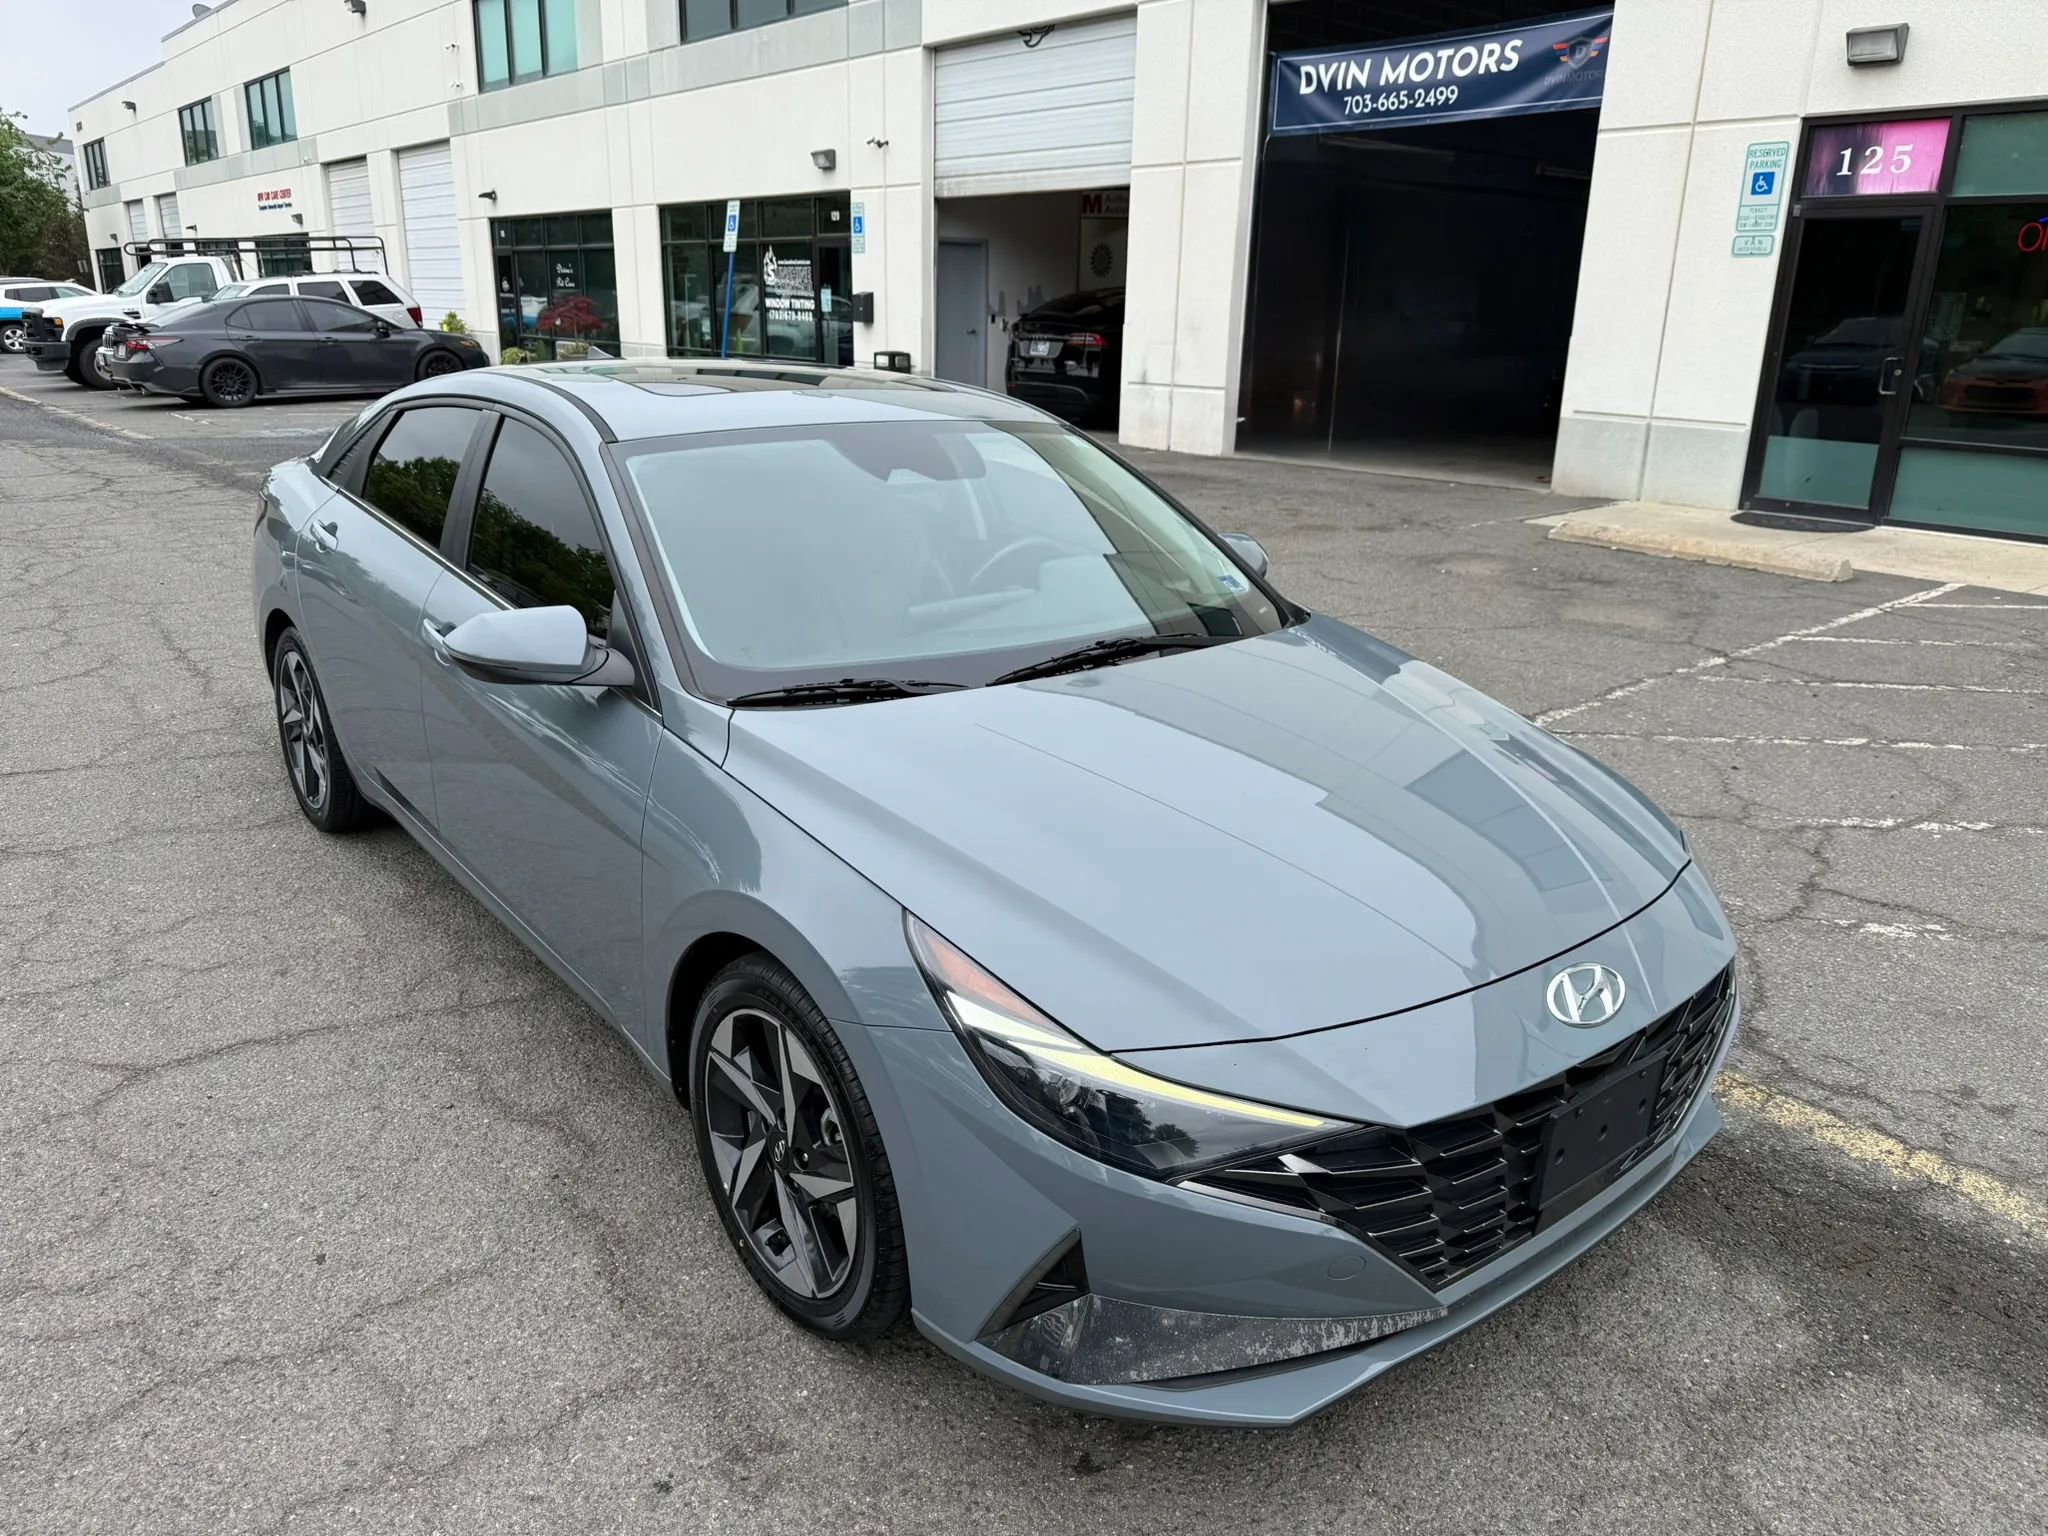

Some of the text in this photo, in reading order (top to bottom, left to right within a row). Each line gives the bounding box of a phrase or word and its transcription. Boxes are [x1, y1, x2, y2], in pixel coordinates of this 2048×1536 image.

[1299, 39, 1524, 95] DVIN MOTORS
[1343, 86, 1459, 115] 703-665-2499
[1748, 147, 1787, 158] RESERVED
[1836, 144, 1914, 176] 125
[1749, 159, 1783, 169] PARKING
[1082, 194, 1102, 214] M
[765, 298, 790, 309] WINDOW
[790, 298, 815, 310] TINTING
